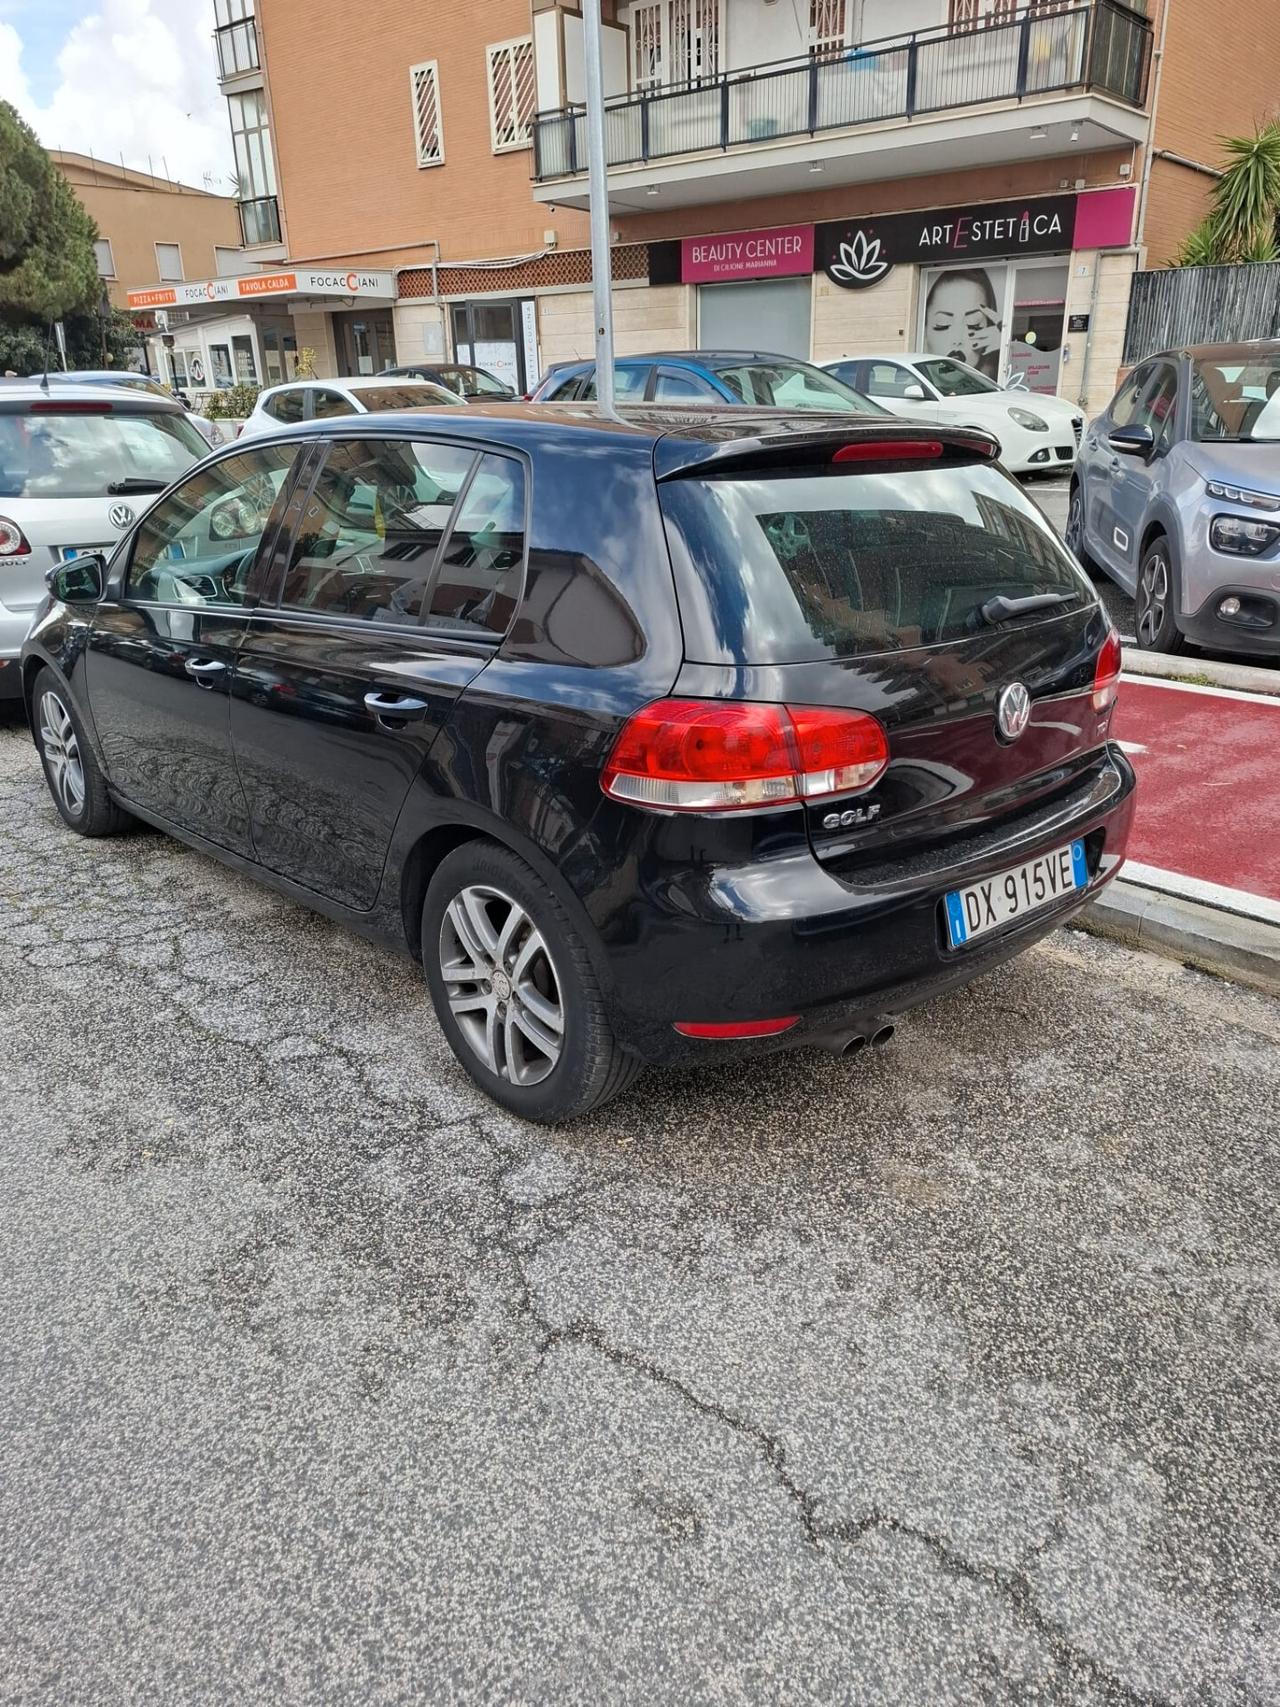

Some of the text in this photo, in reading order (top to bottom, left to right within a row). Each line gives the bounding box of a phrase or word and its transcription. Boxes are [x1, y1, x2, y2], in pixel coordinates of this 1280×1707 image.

[692, 236, 802, 263] BEAUTY CENTER
[745, 259, 777, 269] MARIANNA
[185, 282, 228, 300] FOCACCIANI
[242, 278, 289, 292] TAVOLA CALDA
[310, 272, 378, 291] FOCACCIANI
[823, 804, 881, 829] GOLF
[965, 882, 997, 932] DX
[1004, 850, 1073, 914] 915VE
